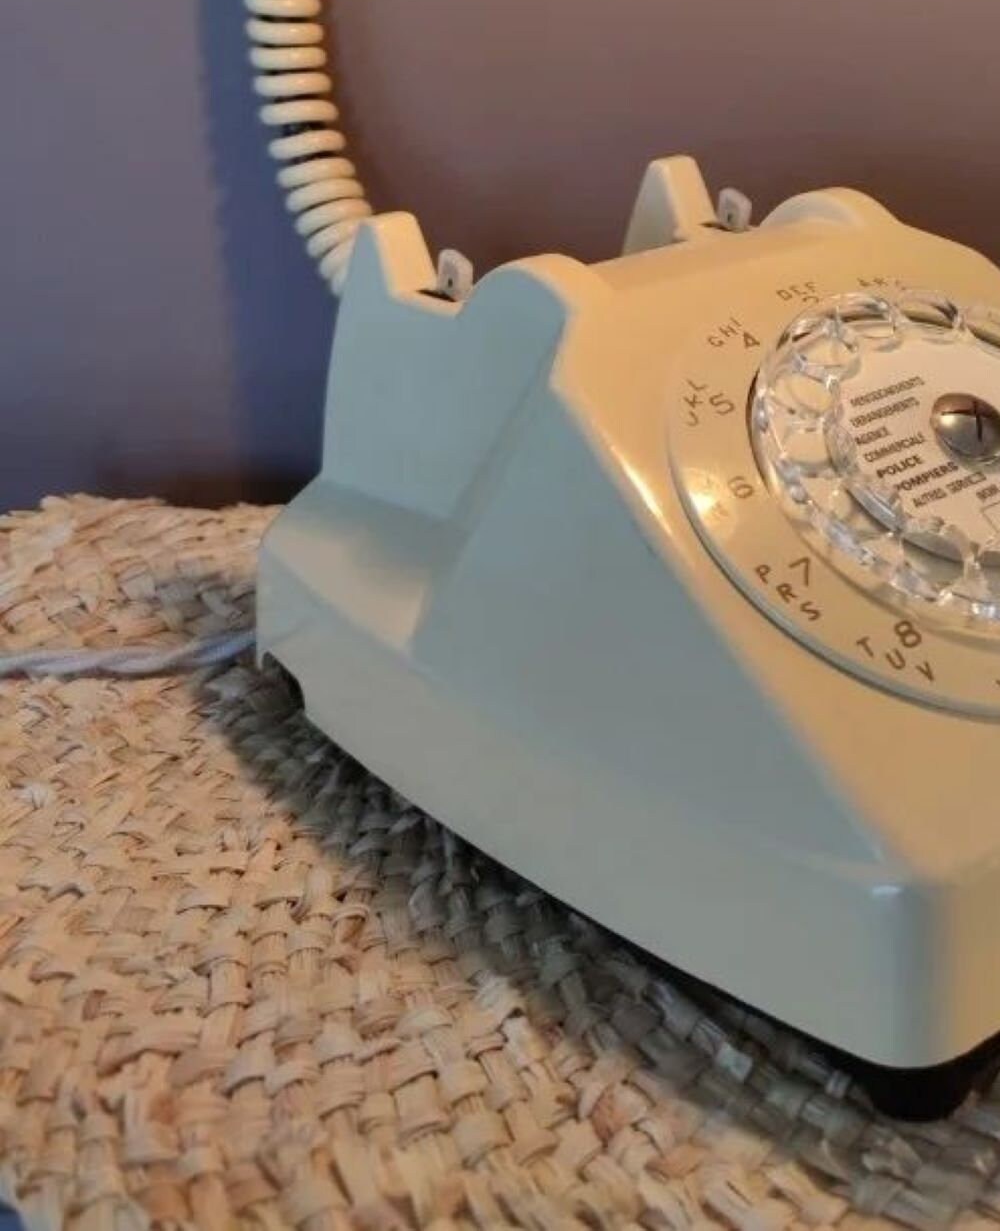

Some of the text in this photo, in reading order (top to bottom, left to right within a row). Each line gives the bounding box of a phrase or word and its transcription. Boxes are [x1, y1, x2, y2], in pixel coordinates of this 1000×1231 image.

[707, 317, 743, 349] GHI
[742, 332, 761, 349] 4
[709, 392, 735, 416] 5
[876, 454, 924, 479] POLICE
[727, 475, 755, 499] 6
[788, 556, 811, 587] 7
[755, 565, 821, 621] PRS
[893, 620, 922, 648] 8
[856, 636, 935, 683] TUV
